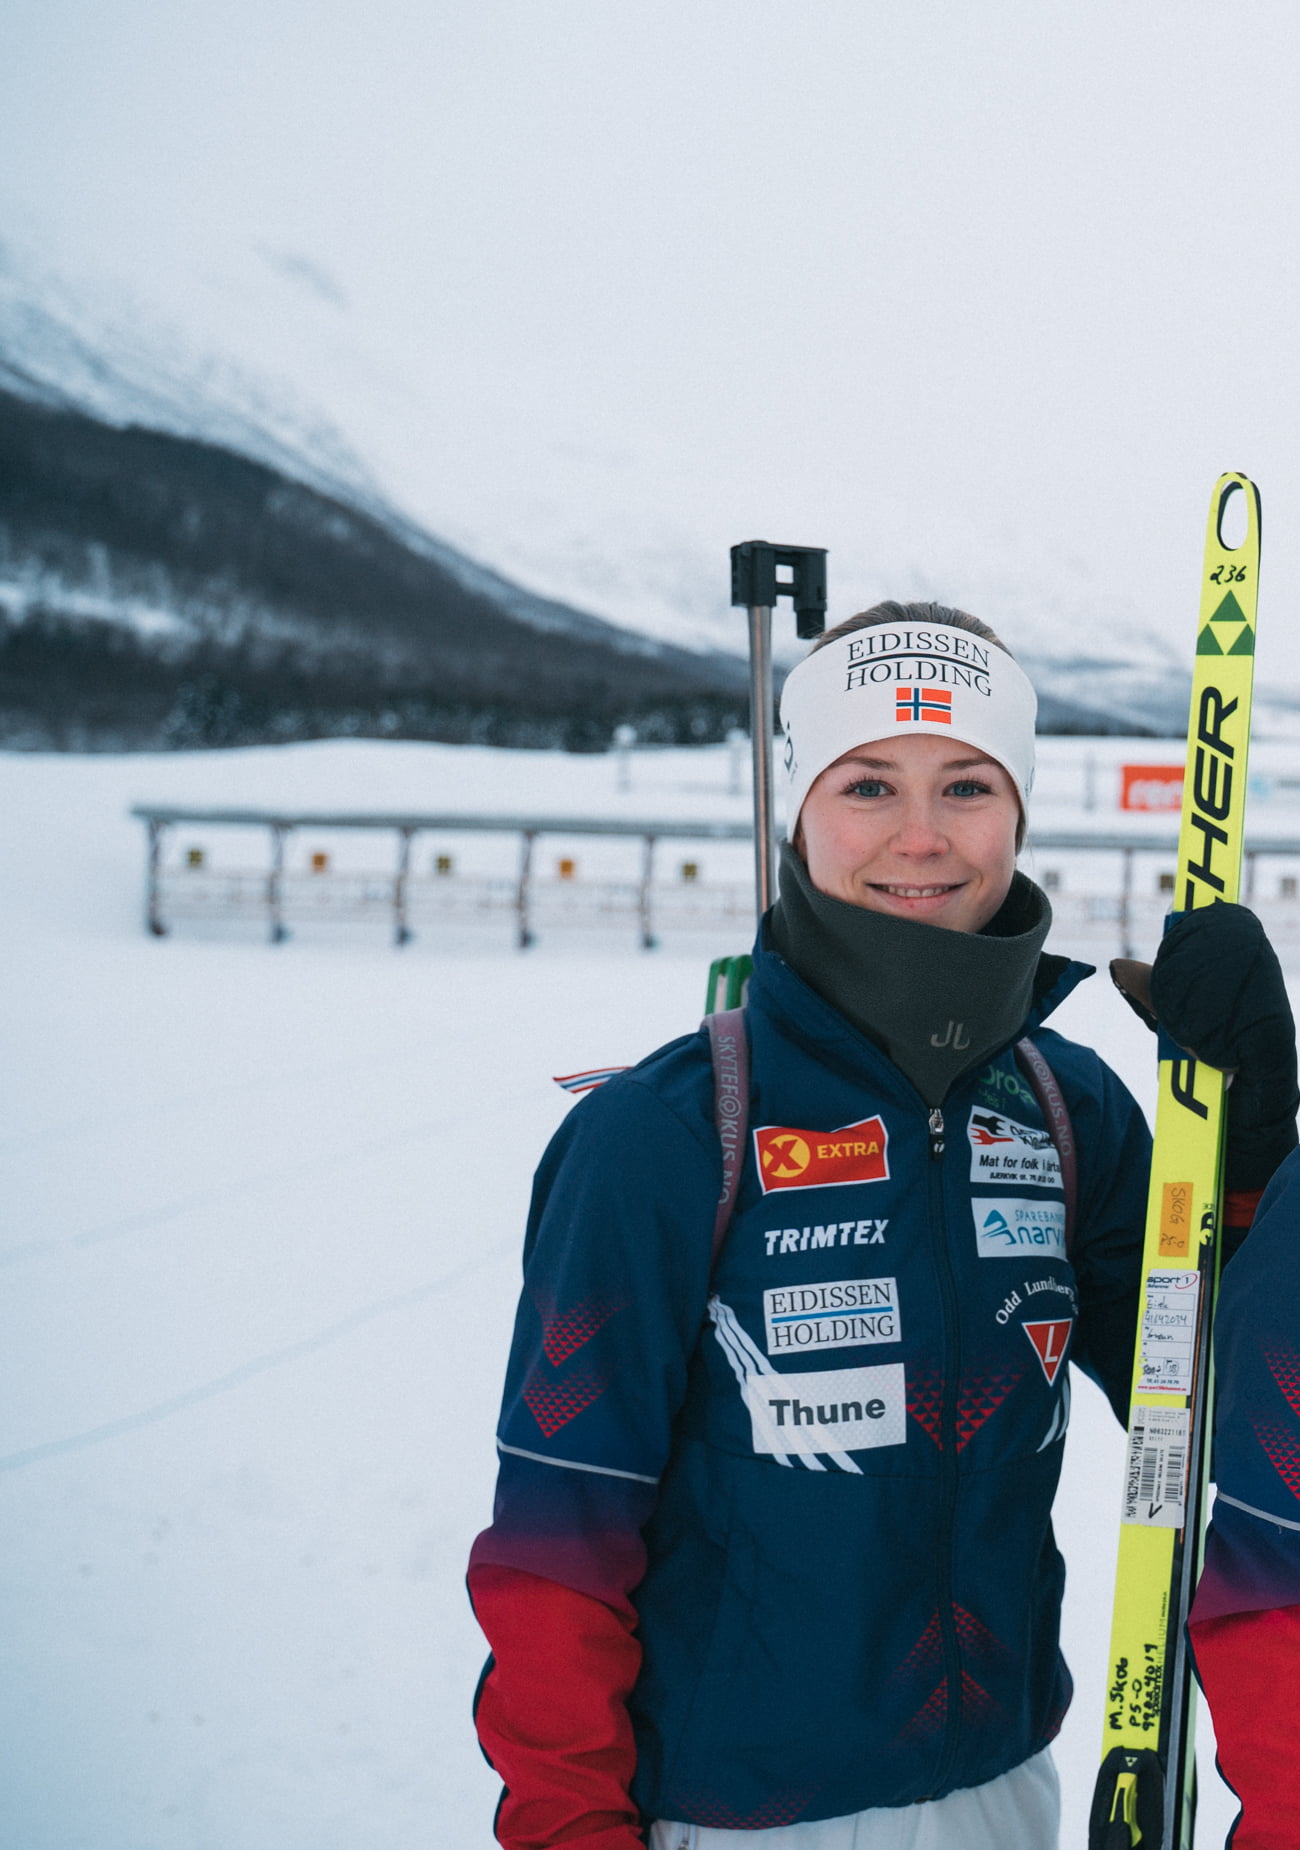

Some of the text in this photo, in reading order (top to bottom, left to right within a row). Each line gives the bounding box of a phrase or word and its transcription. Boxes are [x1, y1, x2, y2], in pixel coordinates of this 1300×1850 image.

[1209, 564, 1248, 586] 236
[847, 631, 990, 668] EIDISSEN
[844, 660, 993, 698] HOLDING
[816, 1141, 880, 1160] EXTRA
[979, 1154, 1000, 1168] Mat
[1002, 1156, 1018, 1168] for
[1020, 1157, 1039, 1170] folk
[764, 1218, 889, 1256] TRIMTEX
[770, 1282, 893, 1315] EIDISSEN
[995, 1290, 1023, 1326] Odd
[773, 1315, 895, 1348] HOLDING
[1044, 1325, 1058, 1364] L
[768, 1398, 886, 1427] Thune
